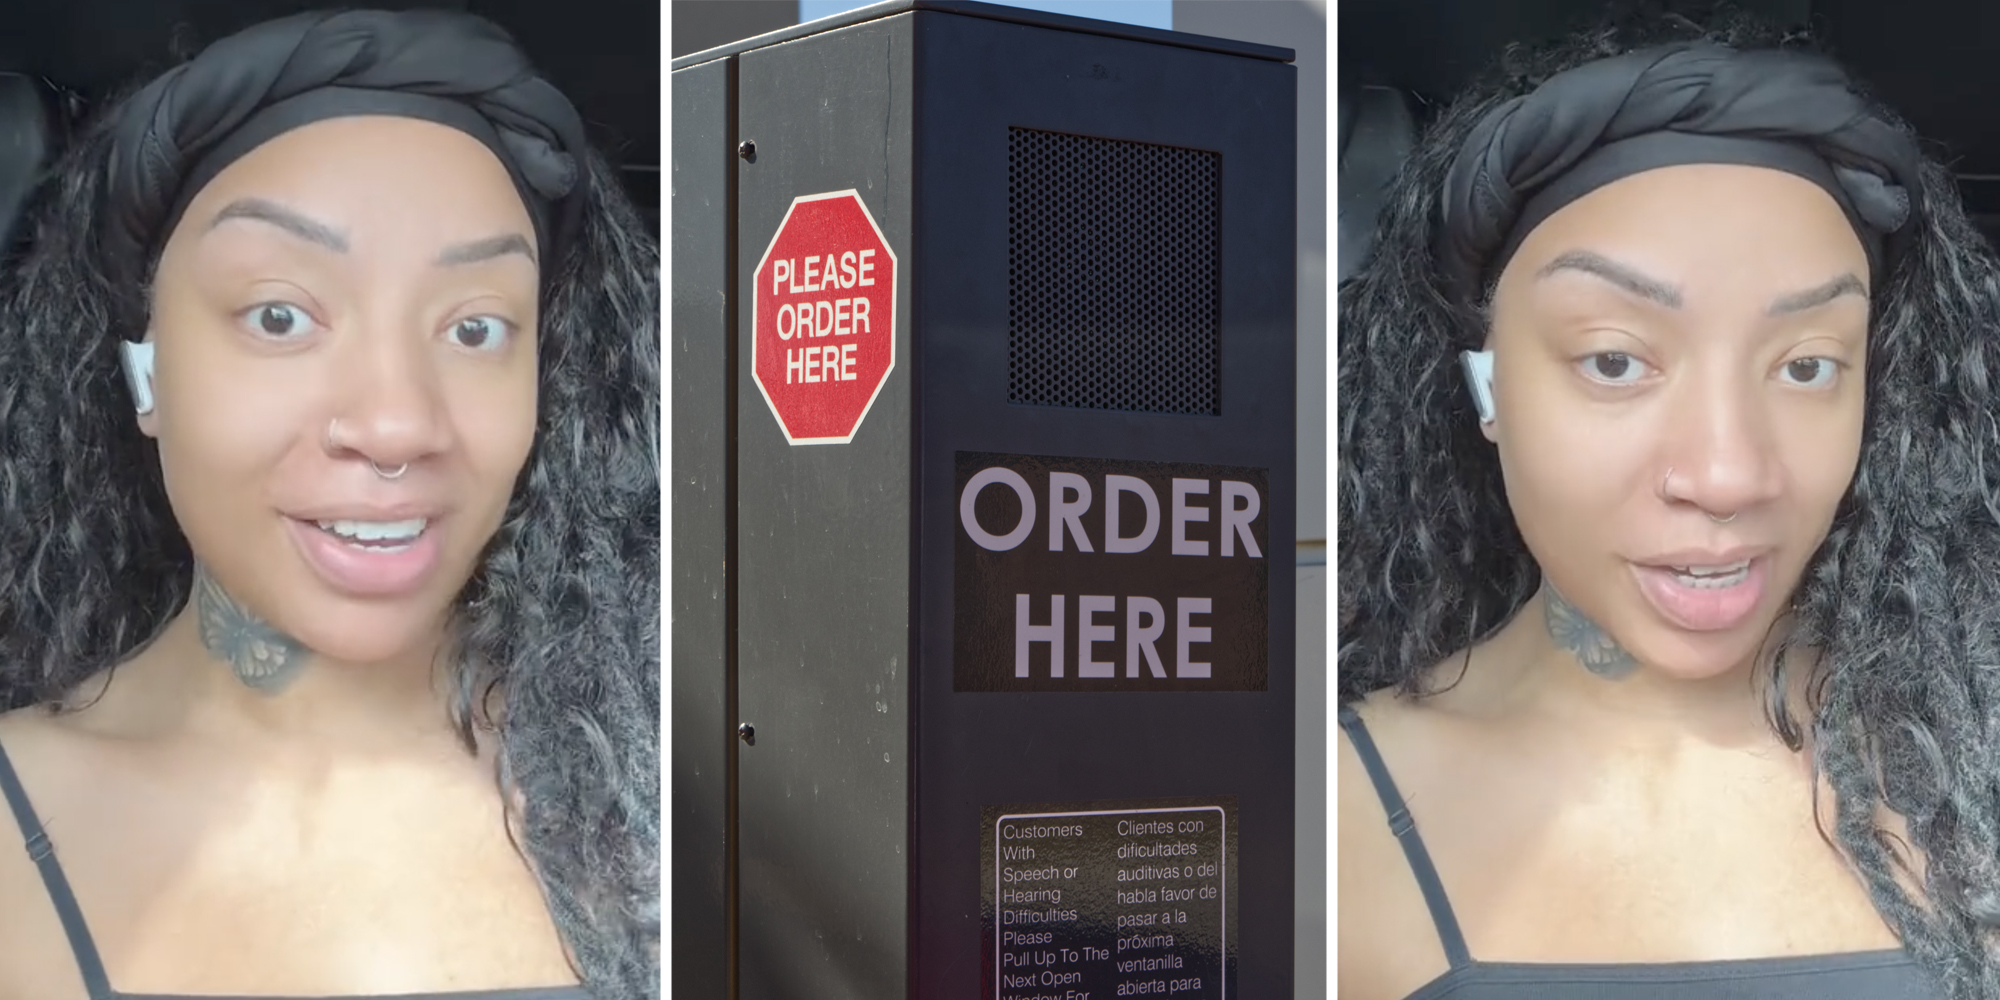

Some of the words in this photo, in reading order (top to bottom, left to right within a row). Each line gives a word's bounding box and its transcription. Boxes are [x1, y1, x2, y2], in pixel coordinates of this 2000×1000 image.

[773, 249, 875, 295] PLEASE
[777, 297, 870, 340] ORDER
[786, 344, 857, 384] HERE
[960, 466, 1263, 558] ORDER
[1015, 593, 1212, 678] HERE
[1003, 824, 1083, 839] Customers
[1117, 820, 1173, 836] Clientes
[1178, 820, 1204, 833] con
[1003, 846, 1035, 860] With
[1117, 841, 1197, 859] dificultades
[1003, 866, 1059, 885] Speech
[1064, 867, 1078, 879] or
[1117, 865, 1180, 881] auditivas
[1184, 865, 1193, 877] o
[1197, 861, 1218, 877] del
[1004, 888, 1061, 904] Hearing
[1117, 887, 1156, 904] habla
[1161, 886, 1195, 902] favor
[1199, 885, 1217, 899] de
[1004, 907, 1077, 925] Difficulties
[1117, 913, 1156, 931] pasar
[1162, 913, 1170, 925] a
[1175, 909, 1186, 923] la
[1004, 931, 1052, 946] Please
[1117, 934, 1173, 954] próxima
[1004, 952, 1030, 967] Pull
[1035, 951, 1056, 967] Up
[1061, 949, 1078, 963] To
[1083, 947, 1109, 961] The
[1117, 955, 1183, 973] ventanilla
[1003, 974, 1036, 988] Next
[1041, 970, 1081, 987] Open
[1117, 979, 1166, 996] abierta
[1170, 977, 1201, 995] para
[1067, 990, 1090, 1000] For
